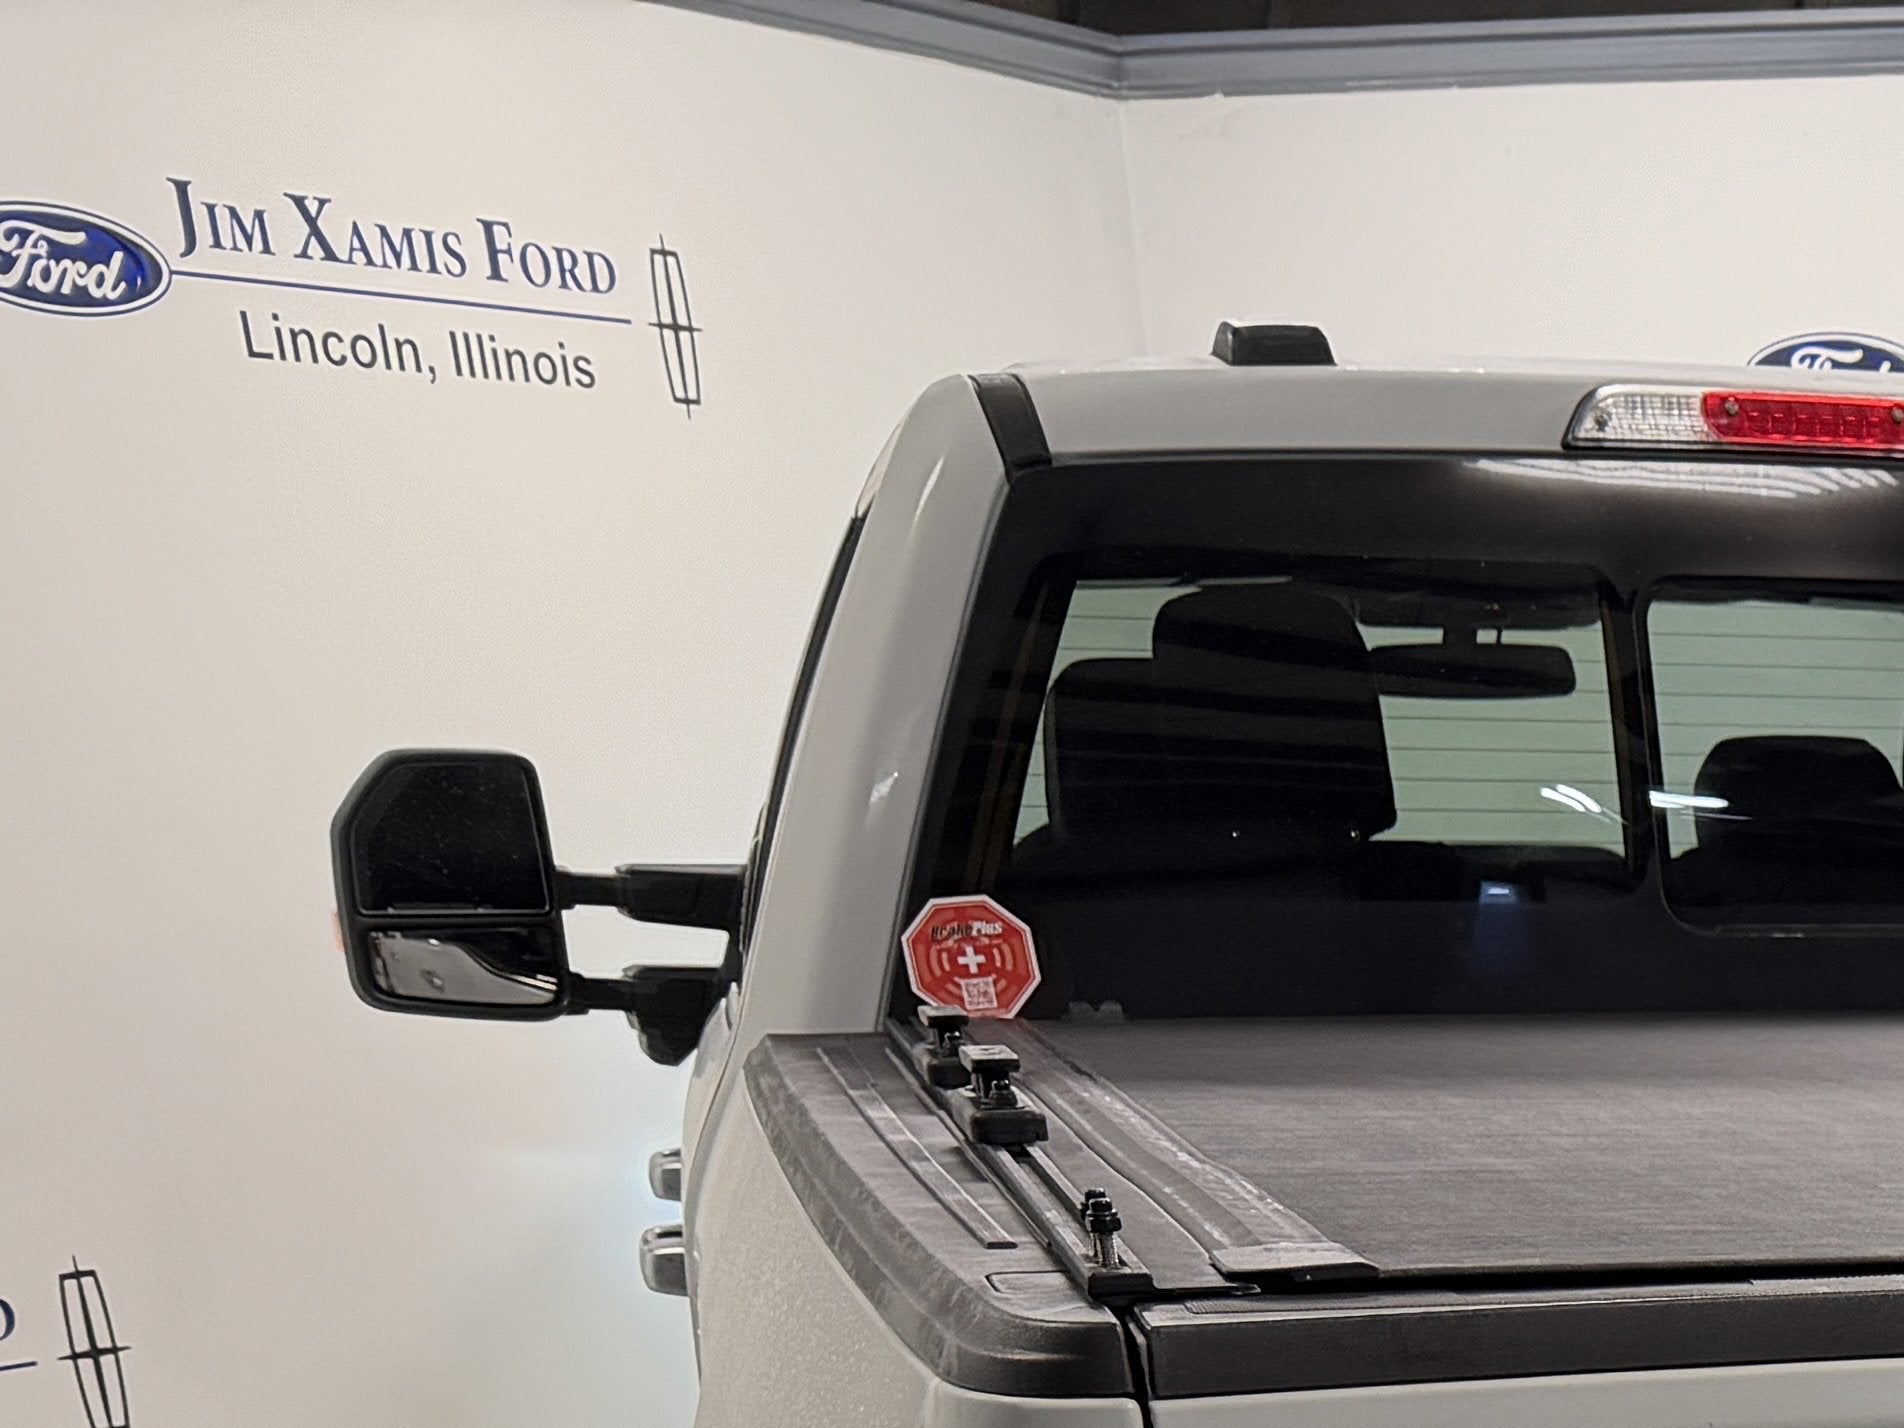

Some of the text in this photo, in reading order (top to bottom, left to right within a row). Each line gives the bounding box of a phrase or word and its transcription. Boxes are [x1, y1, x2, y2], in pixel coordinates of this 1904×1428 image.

[0, 219, 128, 300] Ford
[239, 310, 597, 390] Lincoln, Illinois
